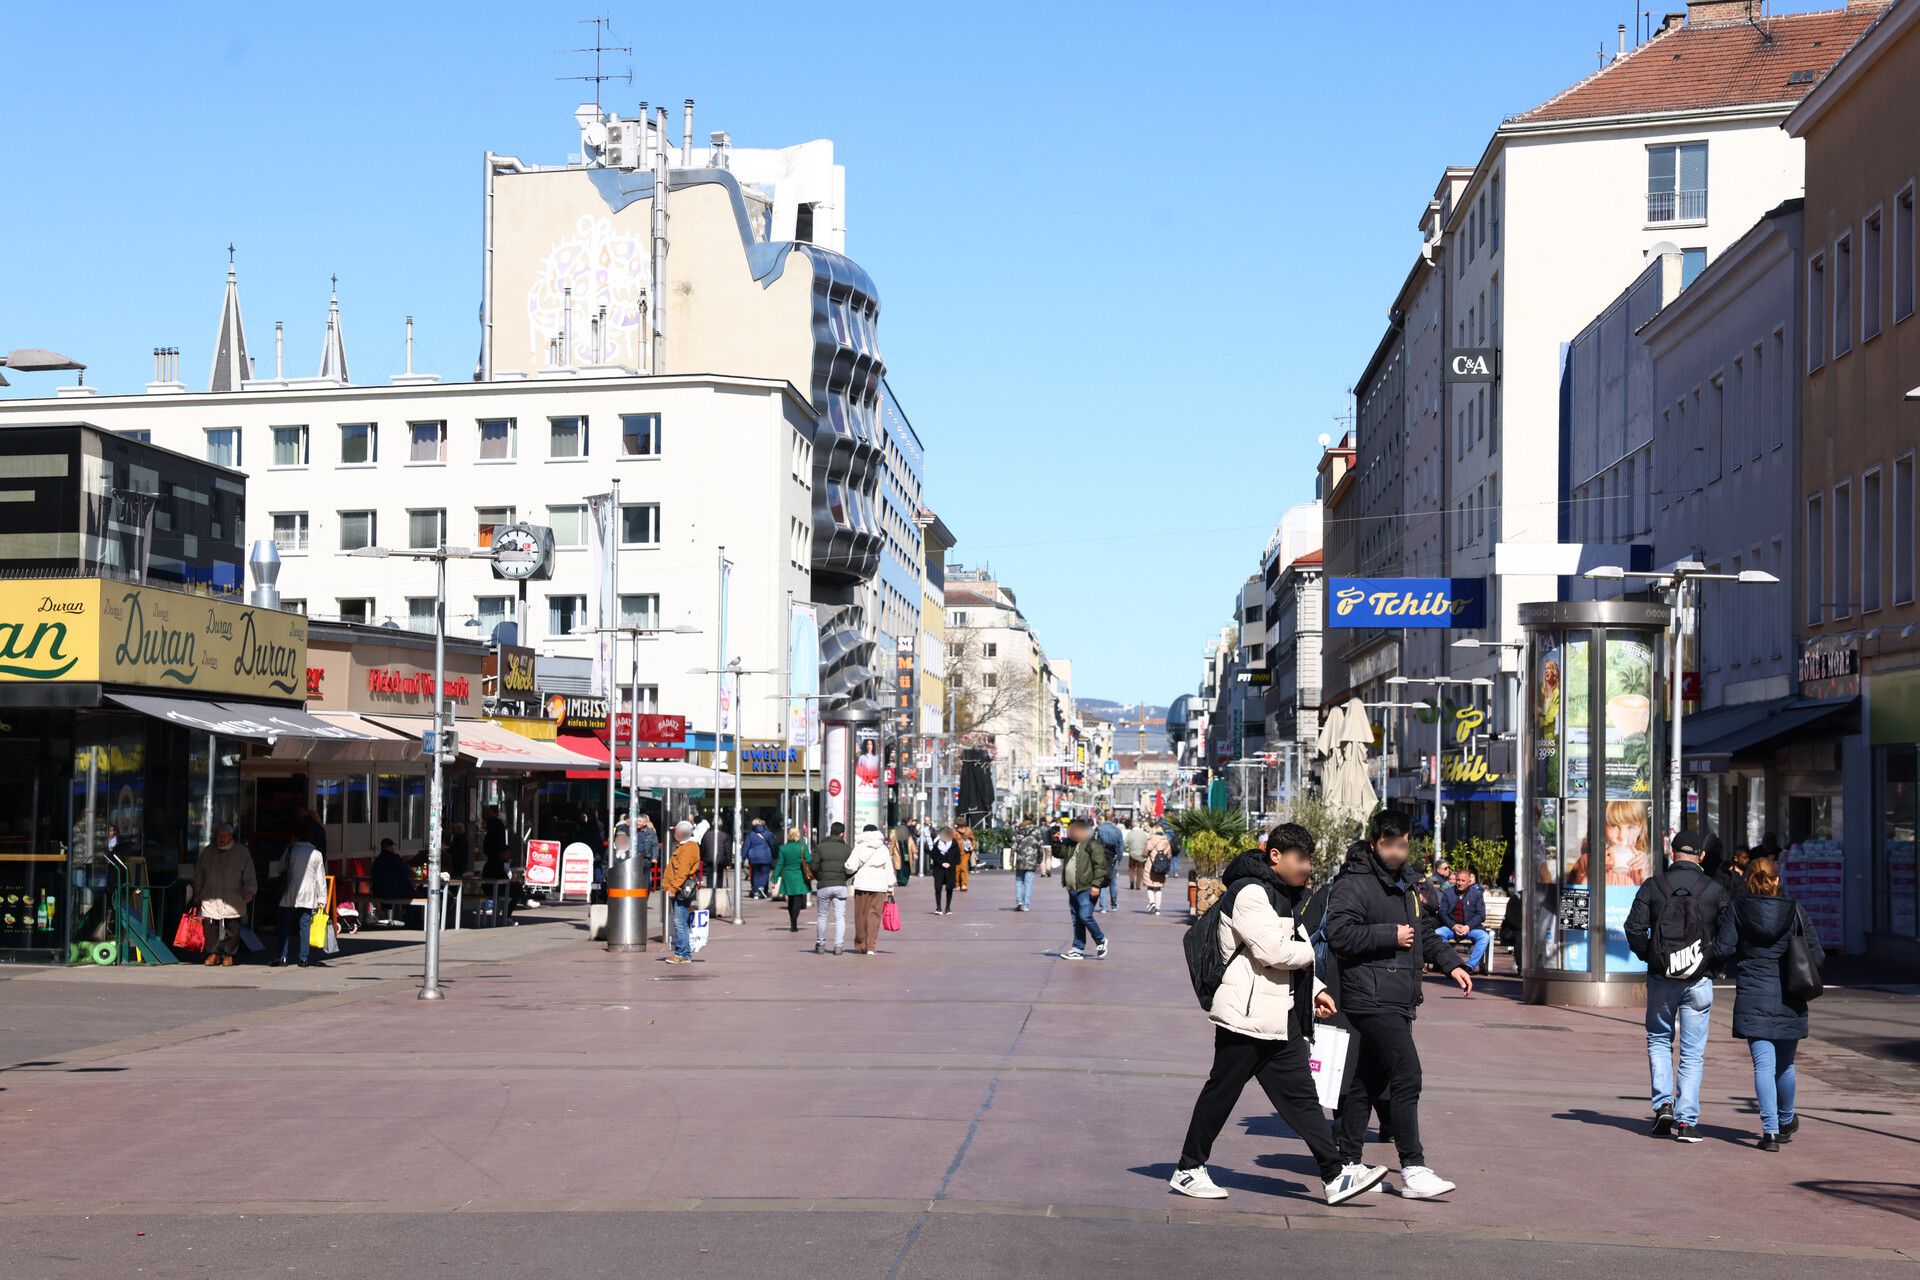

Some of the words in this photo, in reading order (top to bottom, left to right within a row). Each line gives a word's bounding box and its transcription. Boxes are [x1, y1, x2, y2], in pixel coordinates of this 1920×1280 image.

[1452, 355, 1490, 375] C&A
[37, 596, 85, 615] Duran
[1368, 591, 1473, 617] Tchibo
[116, 591, 198, 682] Duran
[205, 608, 233, 640] Duran
[234, 611, 298, 693] Duran
[1828, 650, 1850, 677] MORE
[567, 698, 609, 719] IMBISS
[615, 717, 633, 728] ADAT
[1105, 763, 1115, 775] U
[1669, 938, 1703, 975] NIKE
